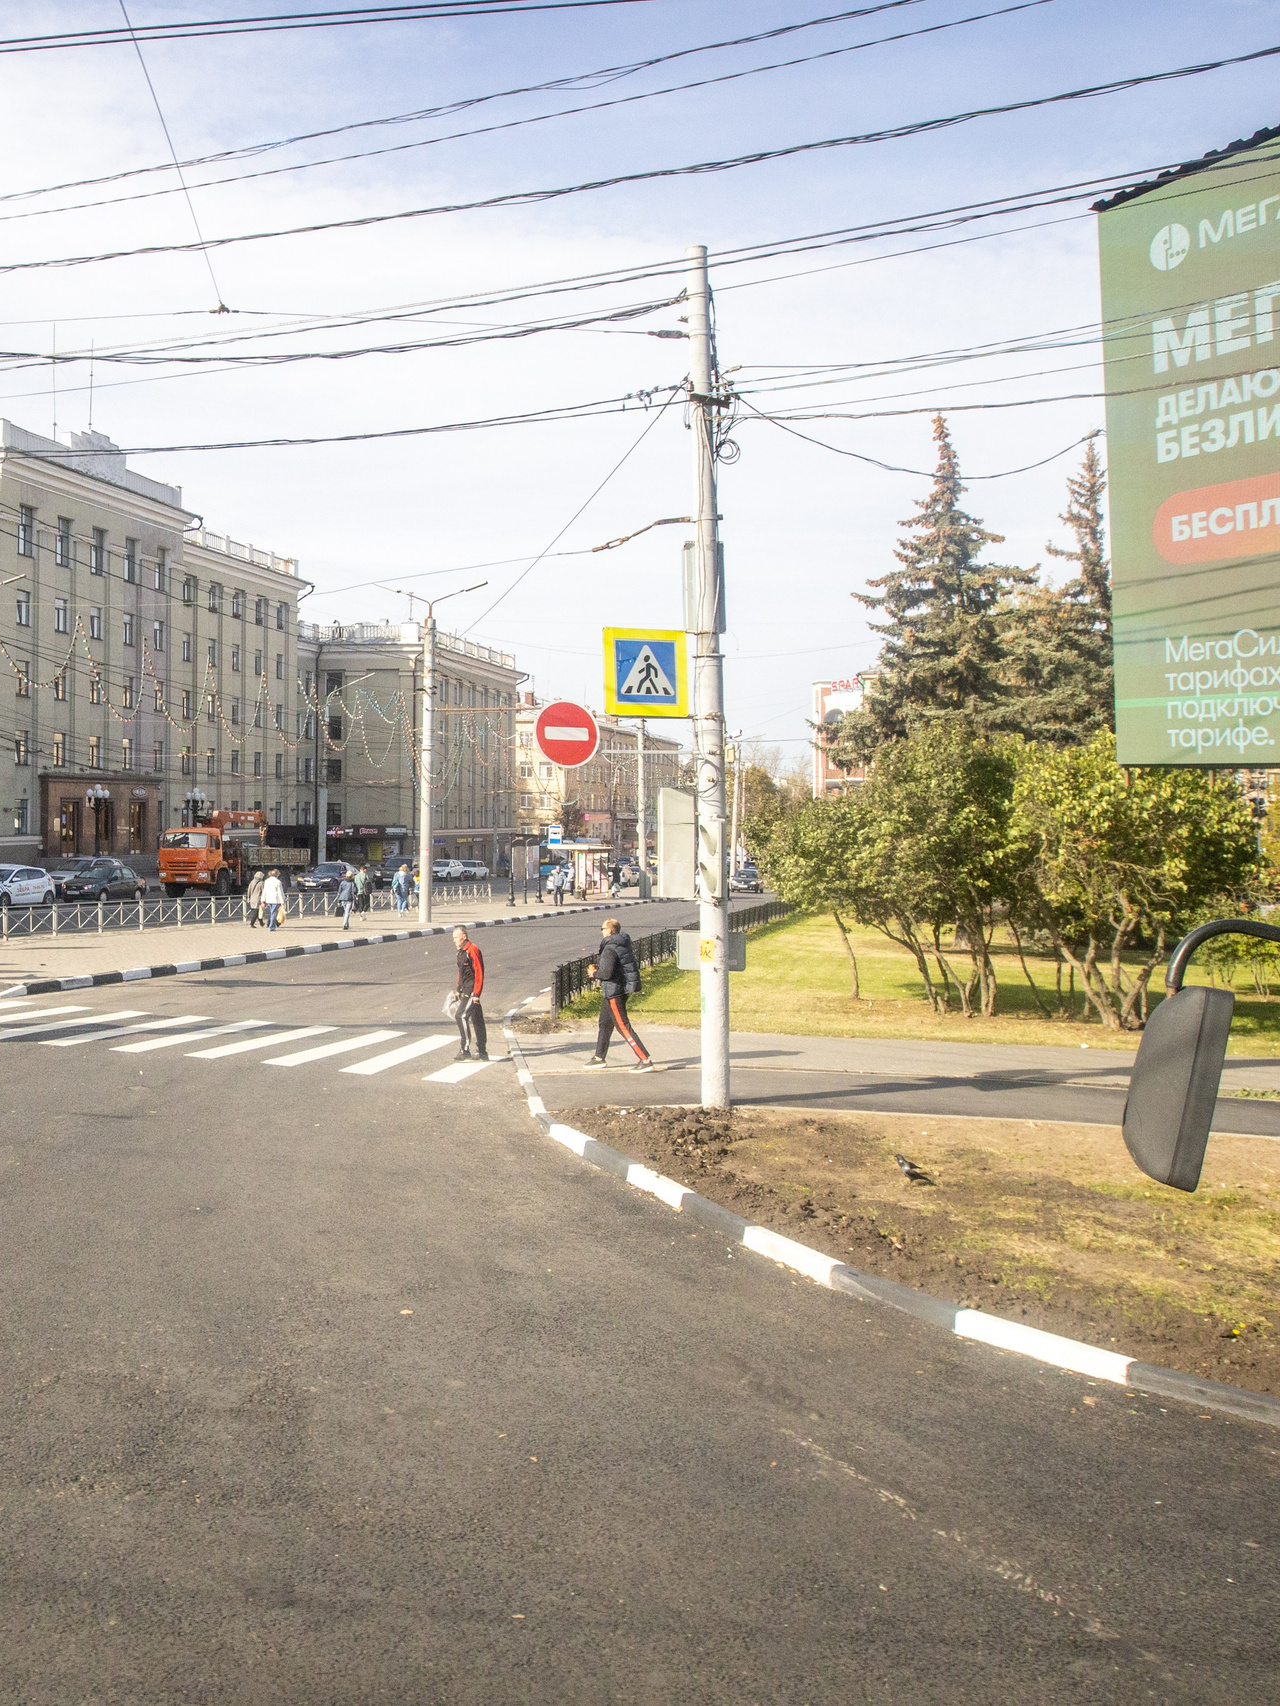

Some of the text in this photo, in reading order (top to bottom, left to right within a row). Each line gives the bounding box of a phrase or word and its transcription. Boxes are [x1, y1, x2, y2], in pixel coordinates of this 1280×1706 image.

[1198, 194, 1280, 249] МЕГ
[1155, 368, 1280, 429] ДЕЛАЮ
[1156, 404, 1280, 464] БЕЗЛИ
[831, 677, 860, 692] SPAR
[1167, 718, 1275, 755] тарифе.
